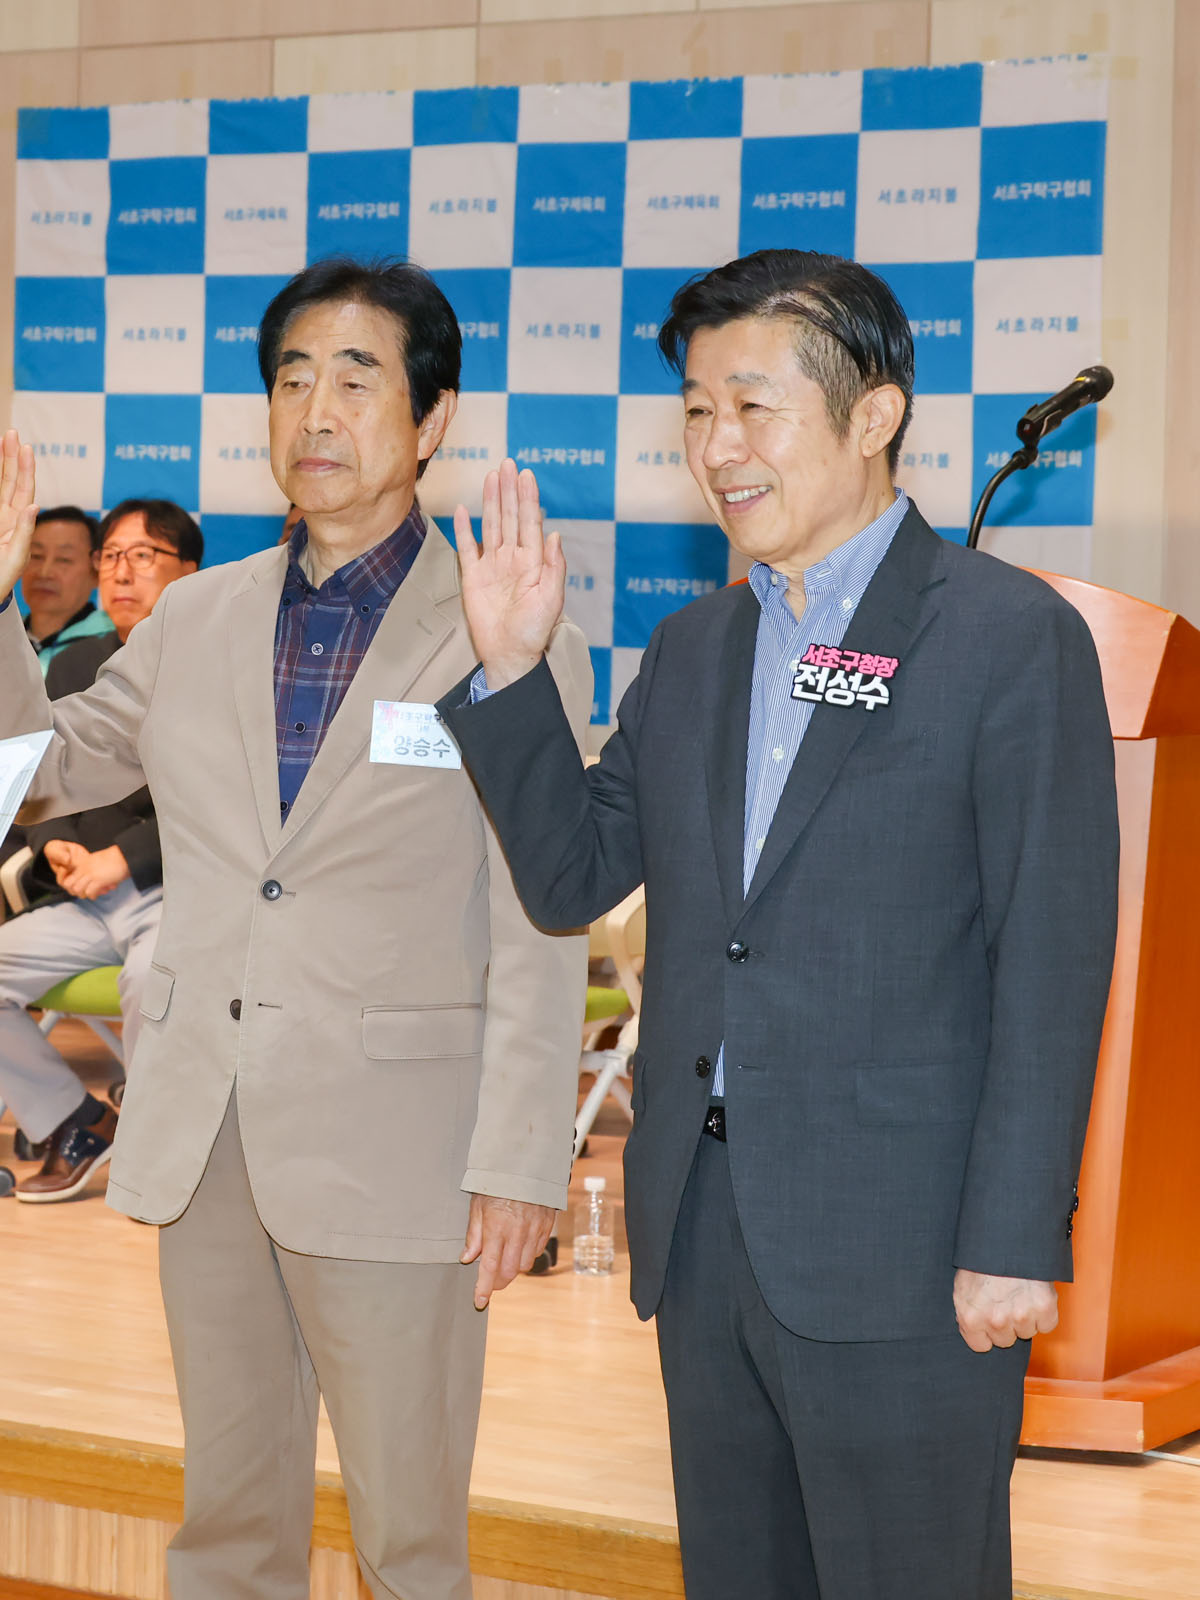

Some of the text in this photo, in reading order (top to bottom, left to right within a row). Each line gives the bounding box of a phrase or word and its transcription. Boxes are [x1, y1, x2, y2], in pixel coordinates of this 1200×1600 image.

[877, 187, 958, 205] 서초라지볼
[993, 180, 1092, 201] 서초구탁구협회
[752, 191, 847, 211] 서초구탁구협회
[317, 202, 402, 221] 서초구탁구협회
[995, 316, 1080, 334] 서초라지볼
[21, 326, 97, 344] 서초구탁구협회
[114, 445, 193, 462] 서초구탁구협회
[516, 447, 607, 466] 서초구탁구협회
[903, 452, 950, 469] 라지볼
[801, 644, 899, 678] 서초구청장
[791, 663, 890, 711] 전성수
[394, 735, 451, 758] 양승수
